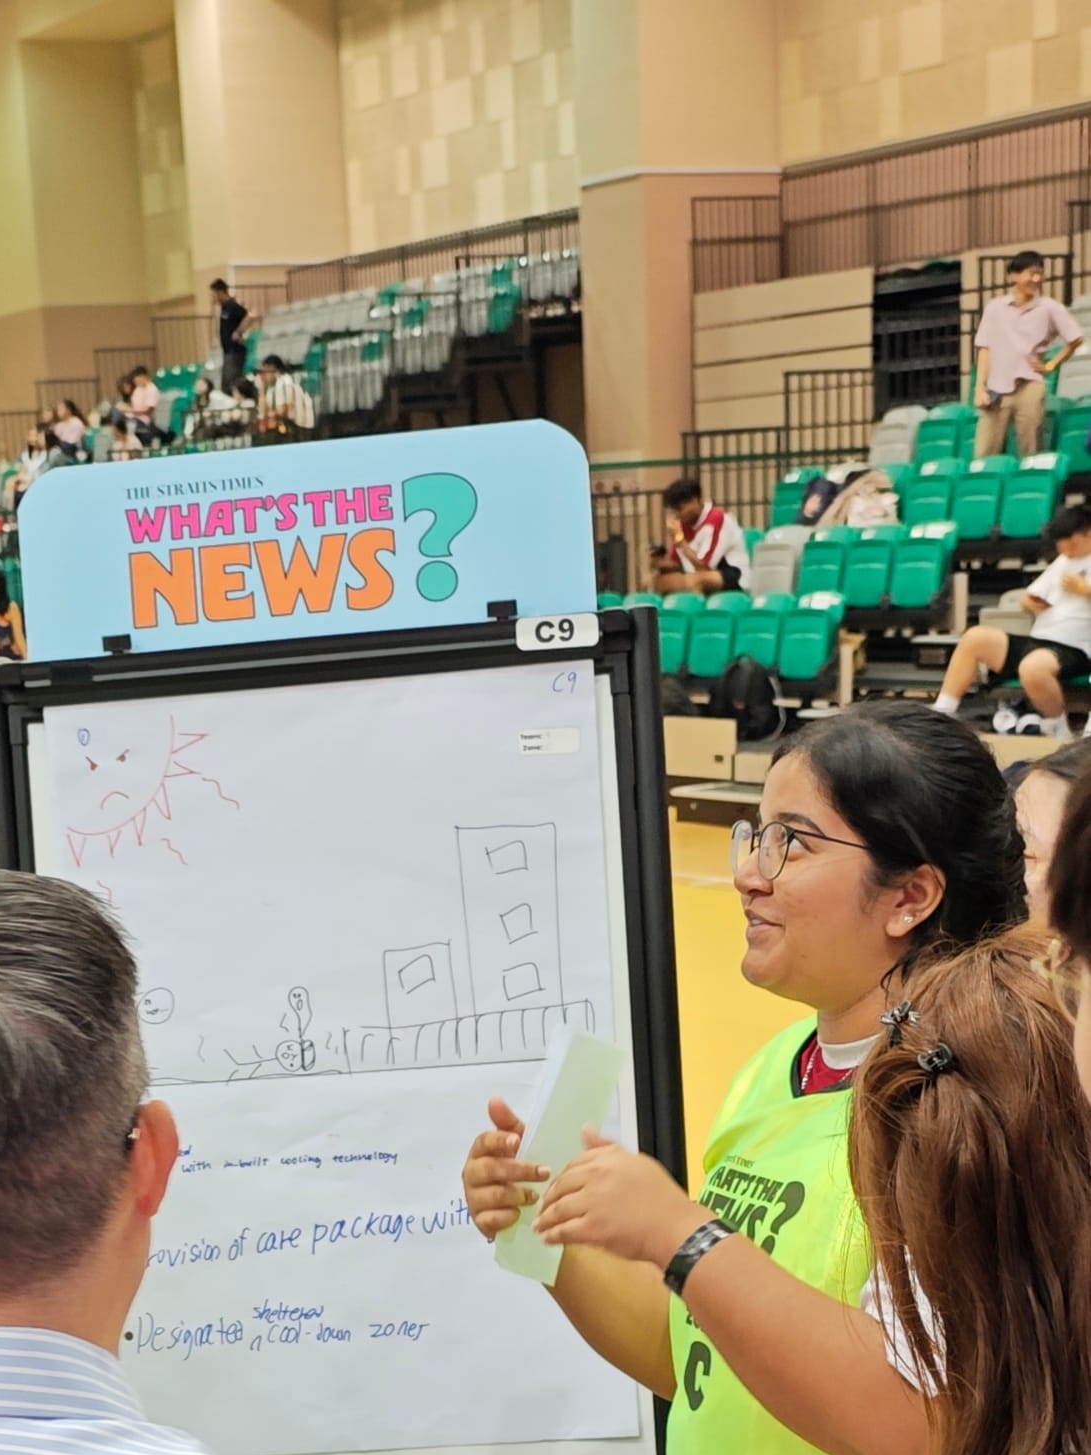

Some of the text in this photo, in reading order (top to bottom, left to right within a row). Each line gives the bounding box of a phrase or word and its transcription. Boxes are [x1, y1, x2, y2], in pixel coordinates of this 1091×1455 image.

[124, 475, 265, 500] THE STRAITS TIMES
[124, 484, 395, 544] WHAT'S THE
[127, 528, 396, 629] NEWS
[534, 618, 576, 643] C9
[551, 671, 577, 694] C9
[145, 1237, 222, 1269] rovision
[228, 1227, 251, 1261] of
[256, 1226, 302, 1254] care
[310, 1212, 416, 1254] package
[683, 1341, 712, 1412] C
